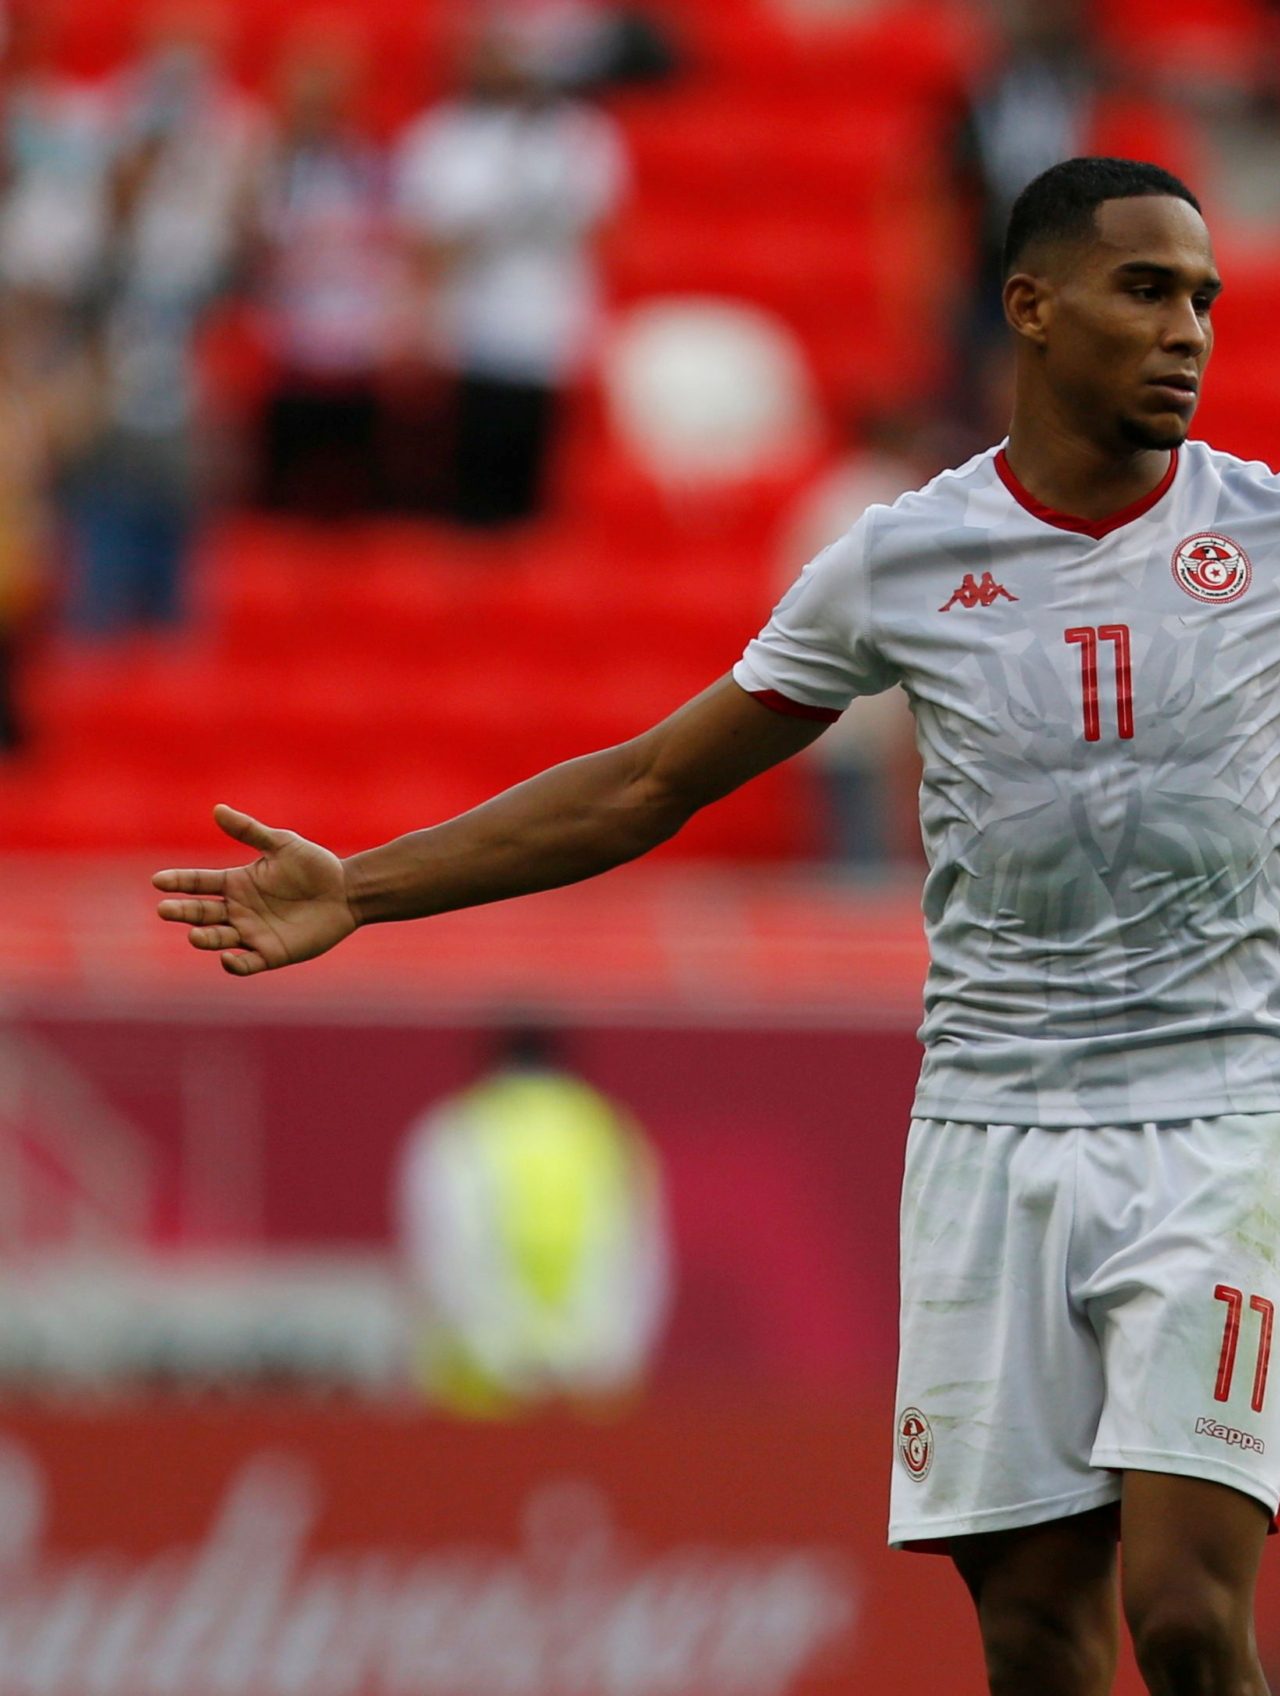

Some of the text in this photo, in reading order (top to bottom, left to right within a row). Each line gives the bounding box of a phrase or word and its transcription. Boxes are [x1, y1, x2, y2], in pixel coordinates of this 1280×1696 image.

[1064, 624, 1134, 742] 11
[1214, 1284, 1275, 1413] 11
[1195, 1417, 1265, 1454] Kappa
